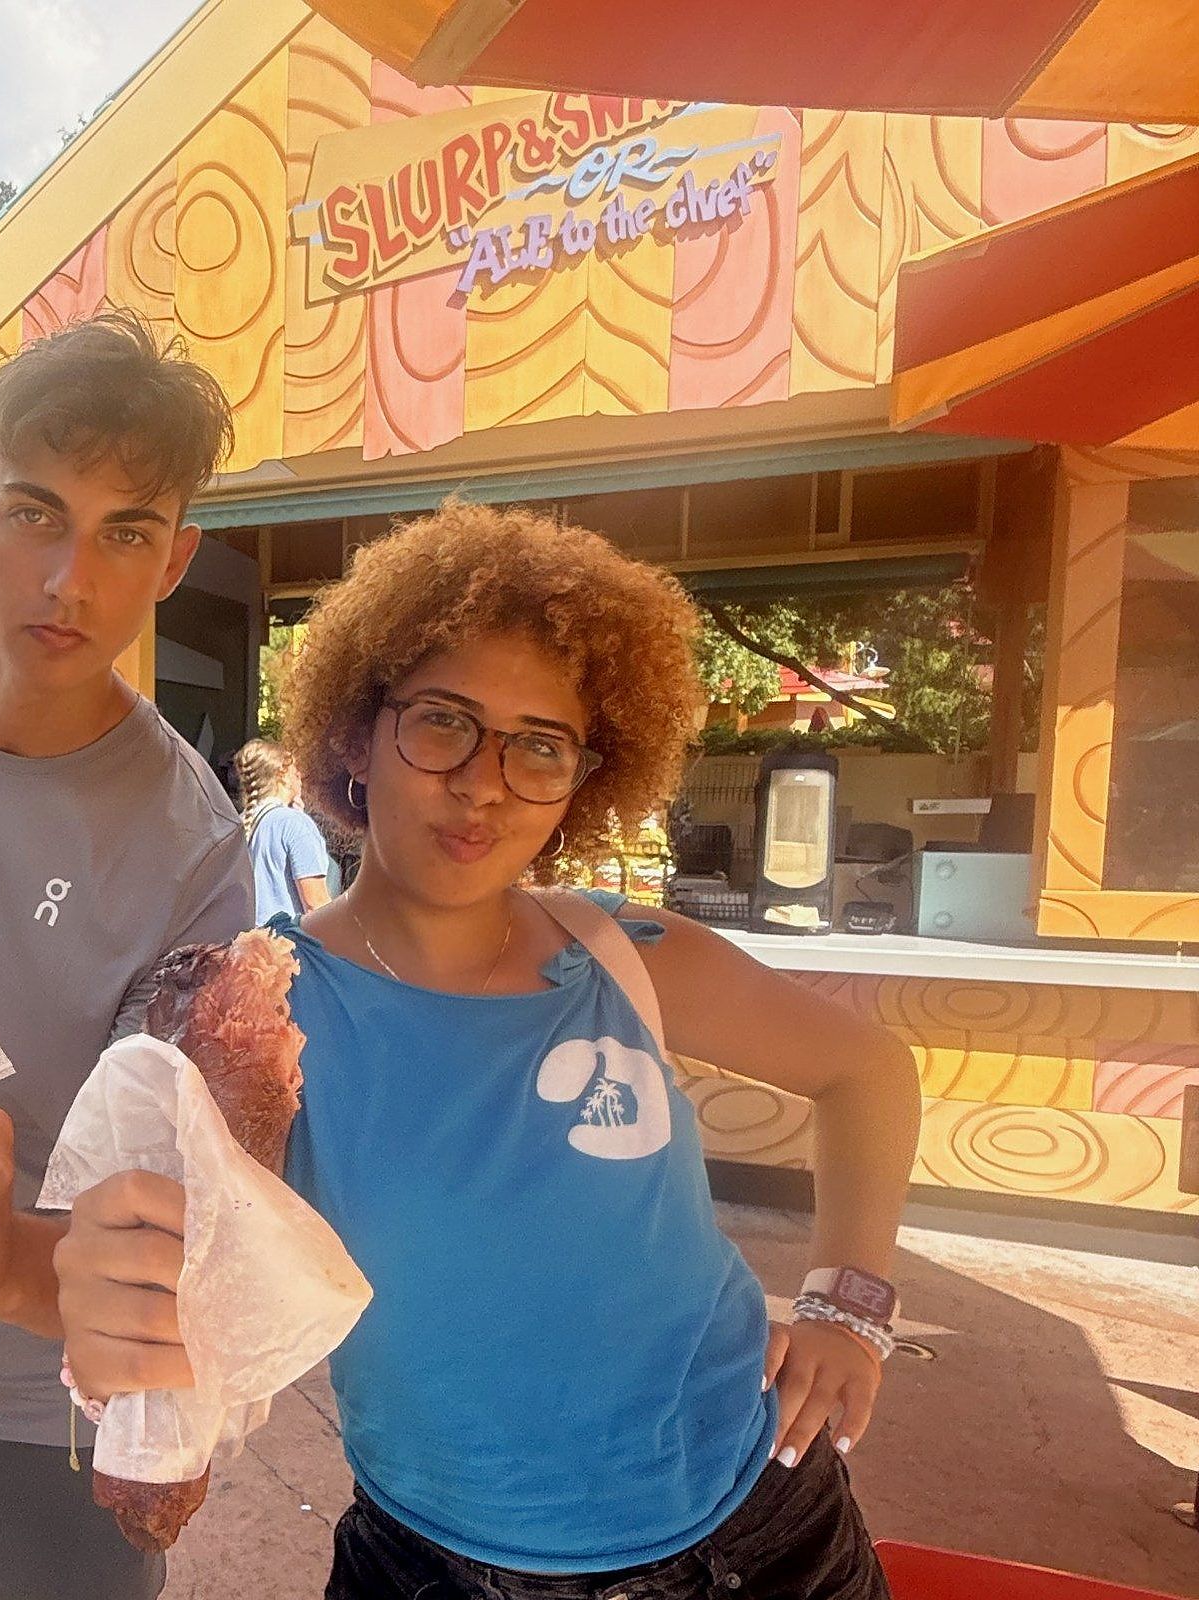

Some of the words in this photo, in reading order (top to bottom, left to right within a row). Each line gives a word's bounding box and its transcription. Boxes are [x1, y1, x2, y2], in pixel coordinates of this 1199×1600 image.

[325, 122, 512, 279] SLURP
[559, 211, 597, 255] to
[601, 192, 657, 243] the
